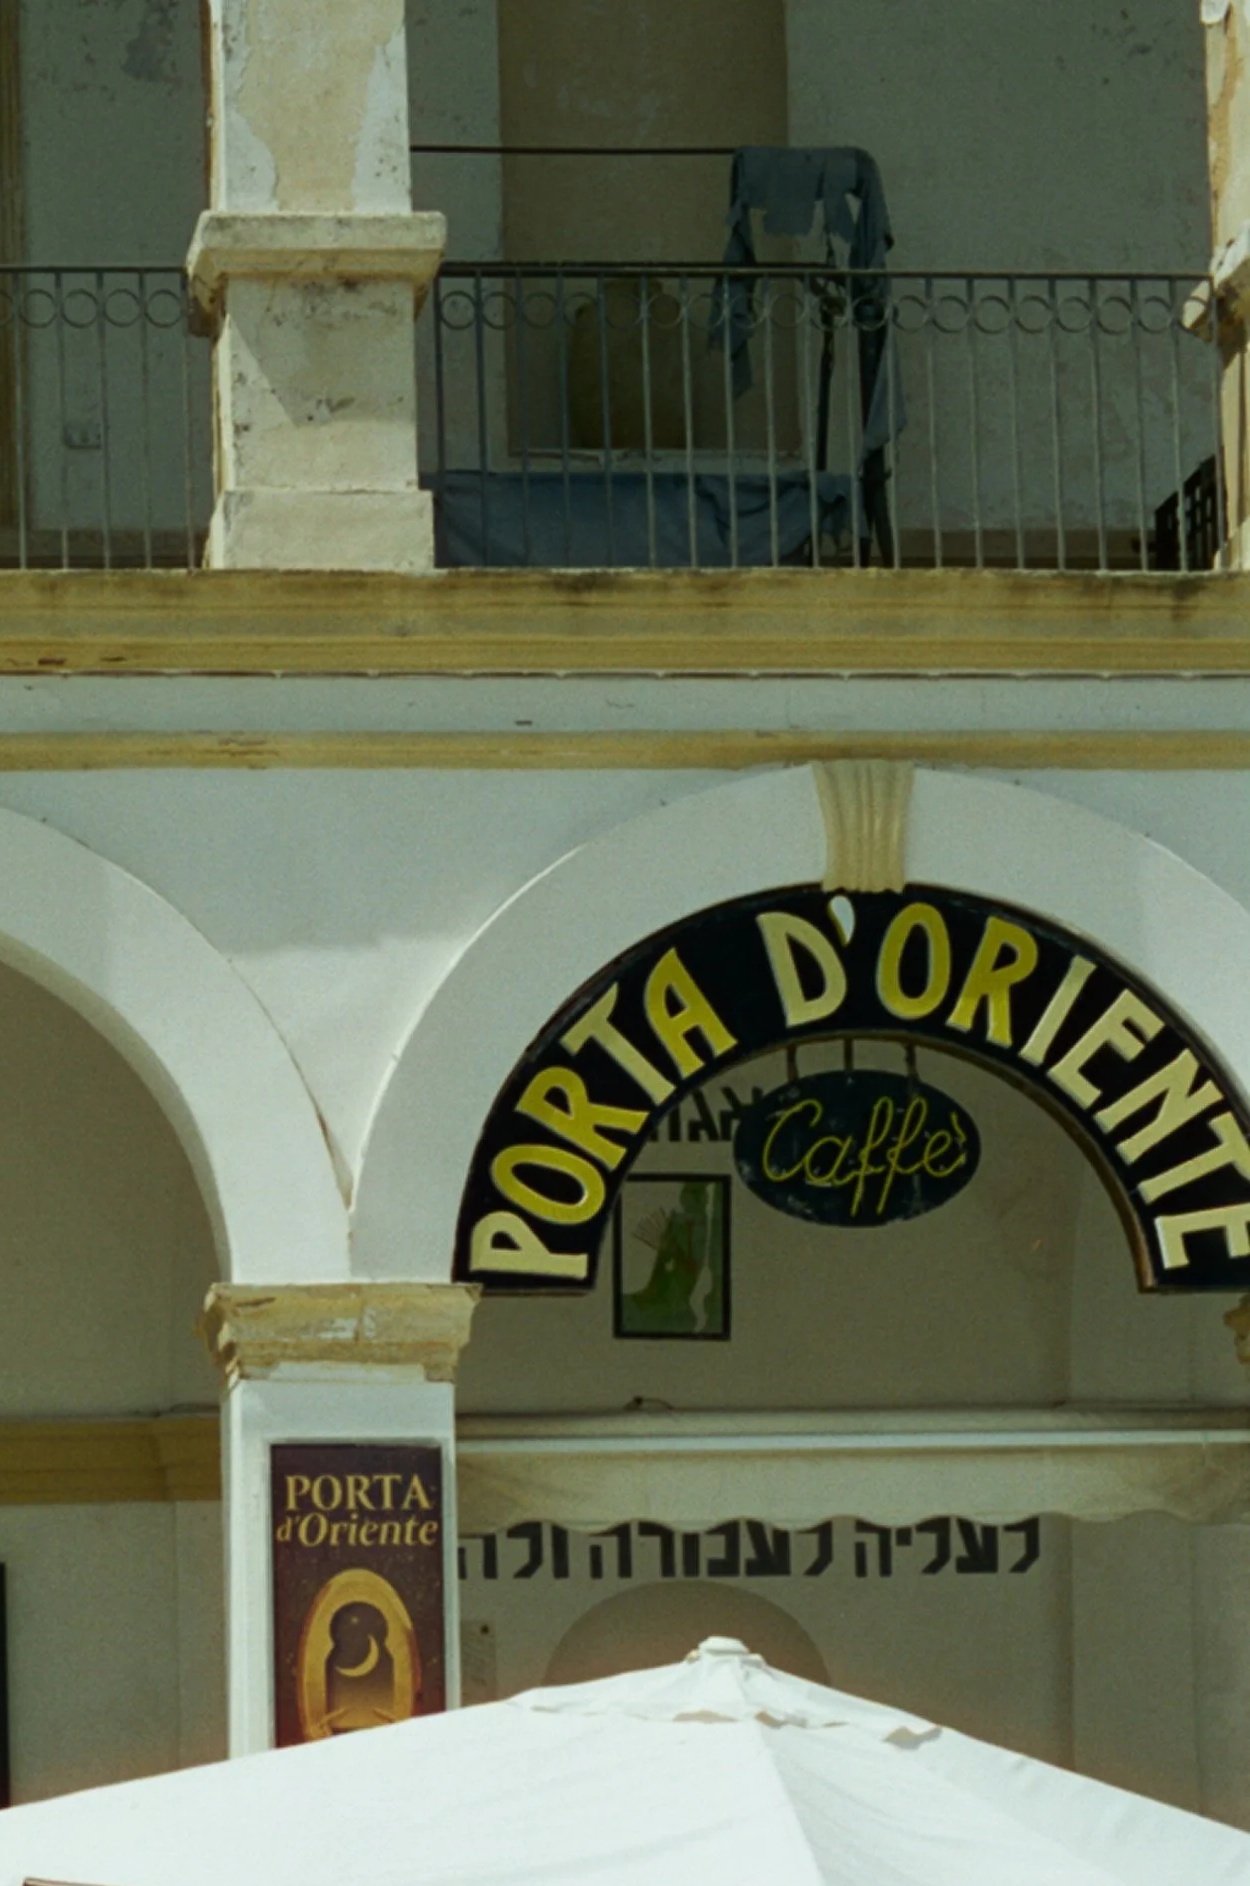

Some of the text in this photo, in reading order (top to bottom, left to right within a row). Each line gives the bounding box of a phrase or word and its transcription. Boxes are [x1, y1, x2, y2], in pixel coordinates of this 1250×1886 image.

[470, 948, 736, 1280] PORTA
[284, 1474, 433, 1511] PORTA
[276, 1511, 439, 1547] d'Oriente
